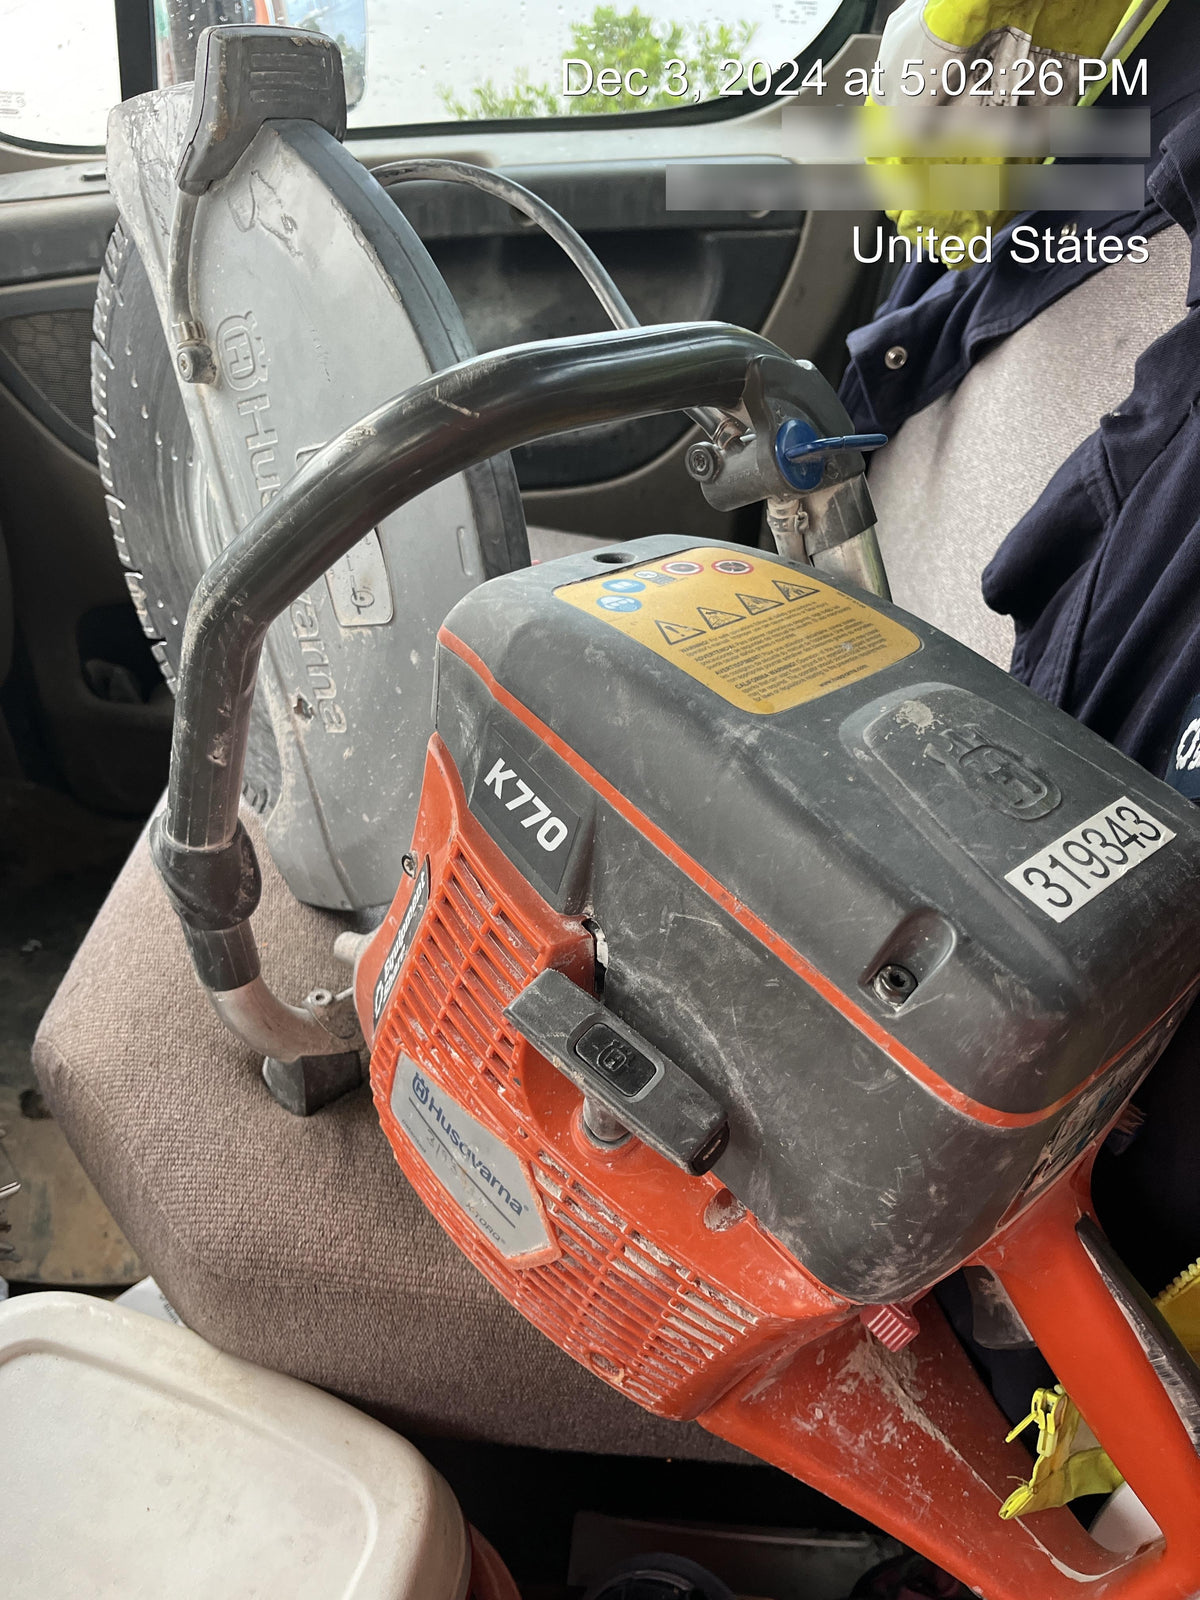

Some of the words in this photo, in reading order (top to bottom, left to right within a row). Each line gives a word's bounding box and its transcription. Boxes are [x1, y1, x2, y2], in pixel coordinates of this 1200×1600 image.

[735, 673, 768, 690] CALIFORNIA
[484, 757, 568, 852] K770
[1022, 806, 1161, 908] 319343
[383, 870, 426, 982] Equipment
[428, 1096, 525, 1217] Husqvarna
